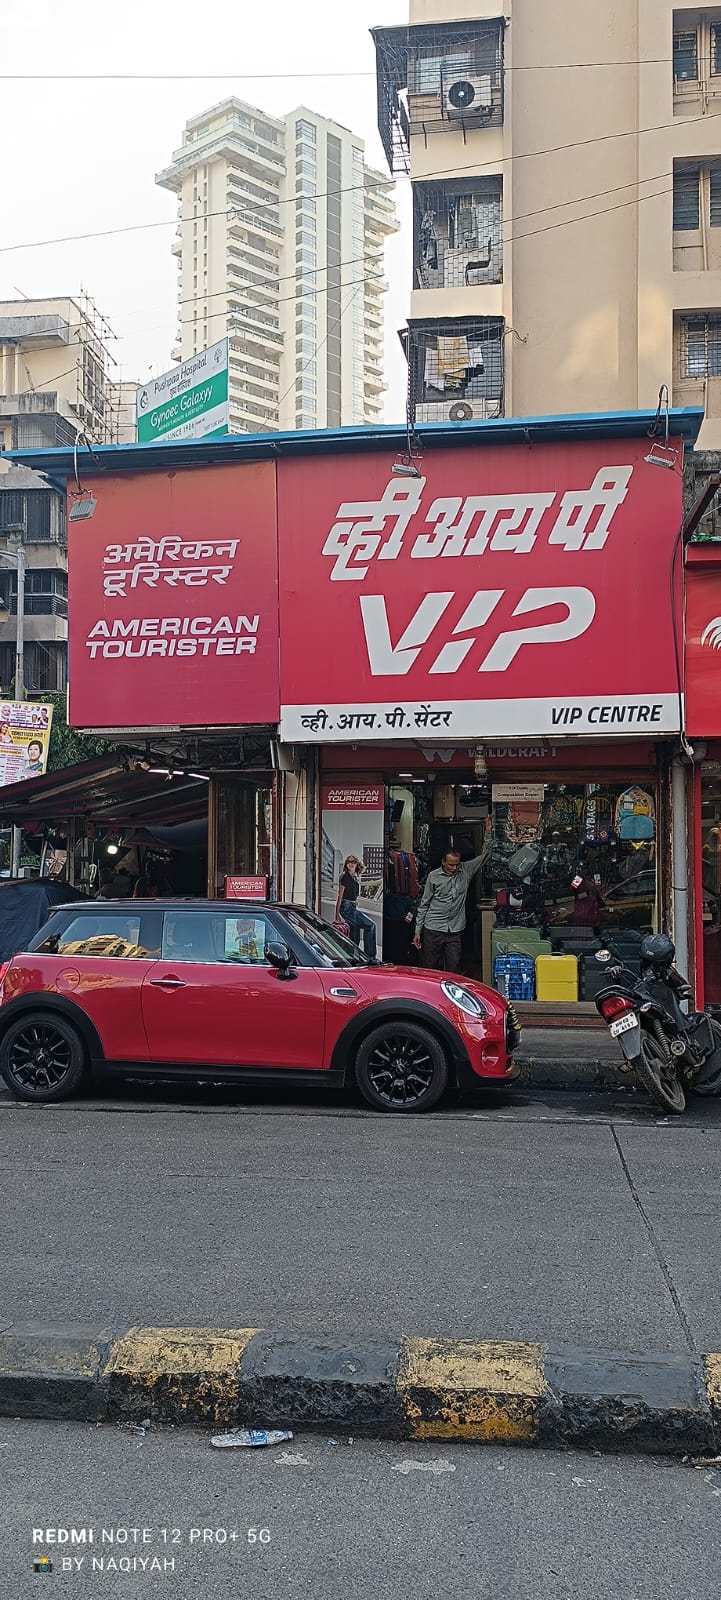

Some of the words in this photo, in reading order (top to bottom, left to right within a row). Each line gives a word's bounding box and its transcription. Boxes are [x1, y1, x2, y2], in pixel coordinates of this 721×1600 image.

[180, 354, 207, 379] Hospital
[150, 404, 179, 428] Gynaec
[180, 385, 213, 411] Galaxyy
[410, 491, 557, 558] आय
[548, 465, 634, 551] पी
[103, 535, 241, 564] अमेरिकन
[103, 562, 233, 597] टूरिस्टर
[88, 615, 260, 638] AMERICAN
[359, 586, 596, 676] VIP
[85, 636, 258, 659] TOURISTER
[551, 707, 583, 725] VIP
[587, 704, 663, 724] CENTRE
[586, 800, 597, 841] SKYBAGS
